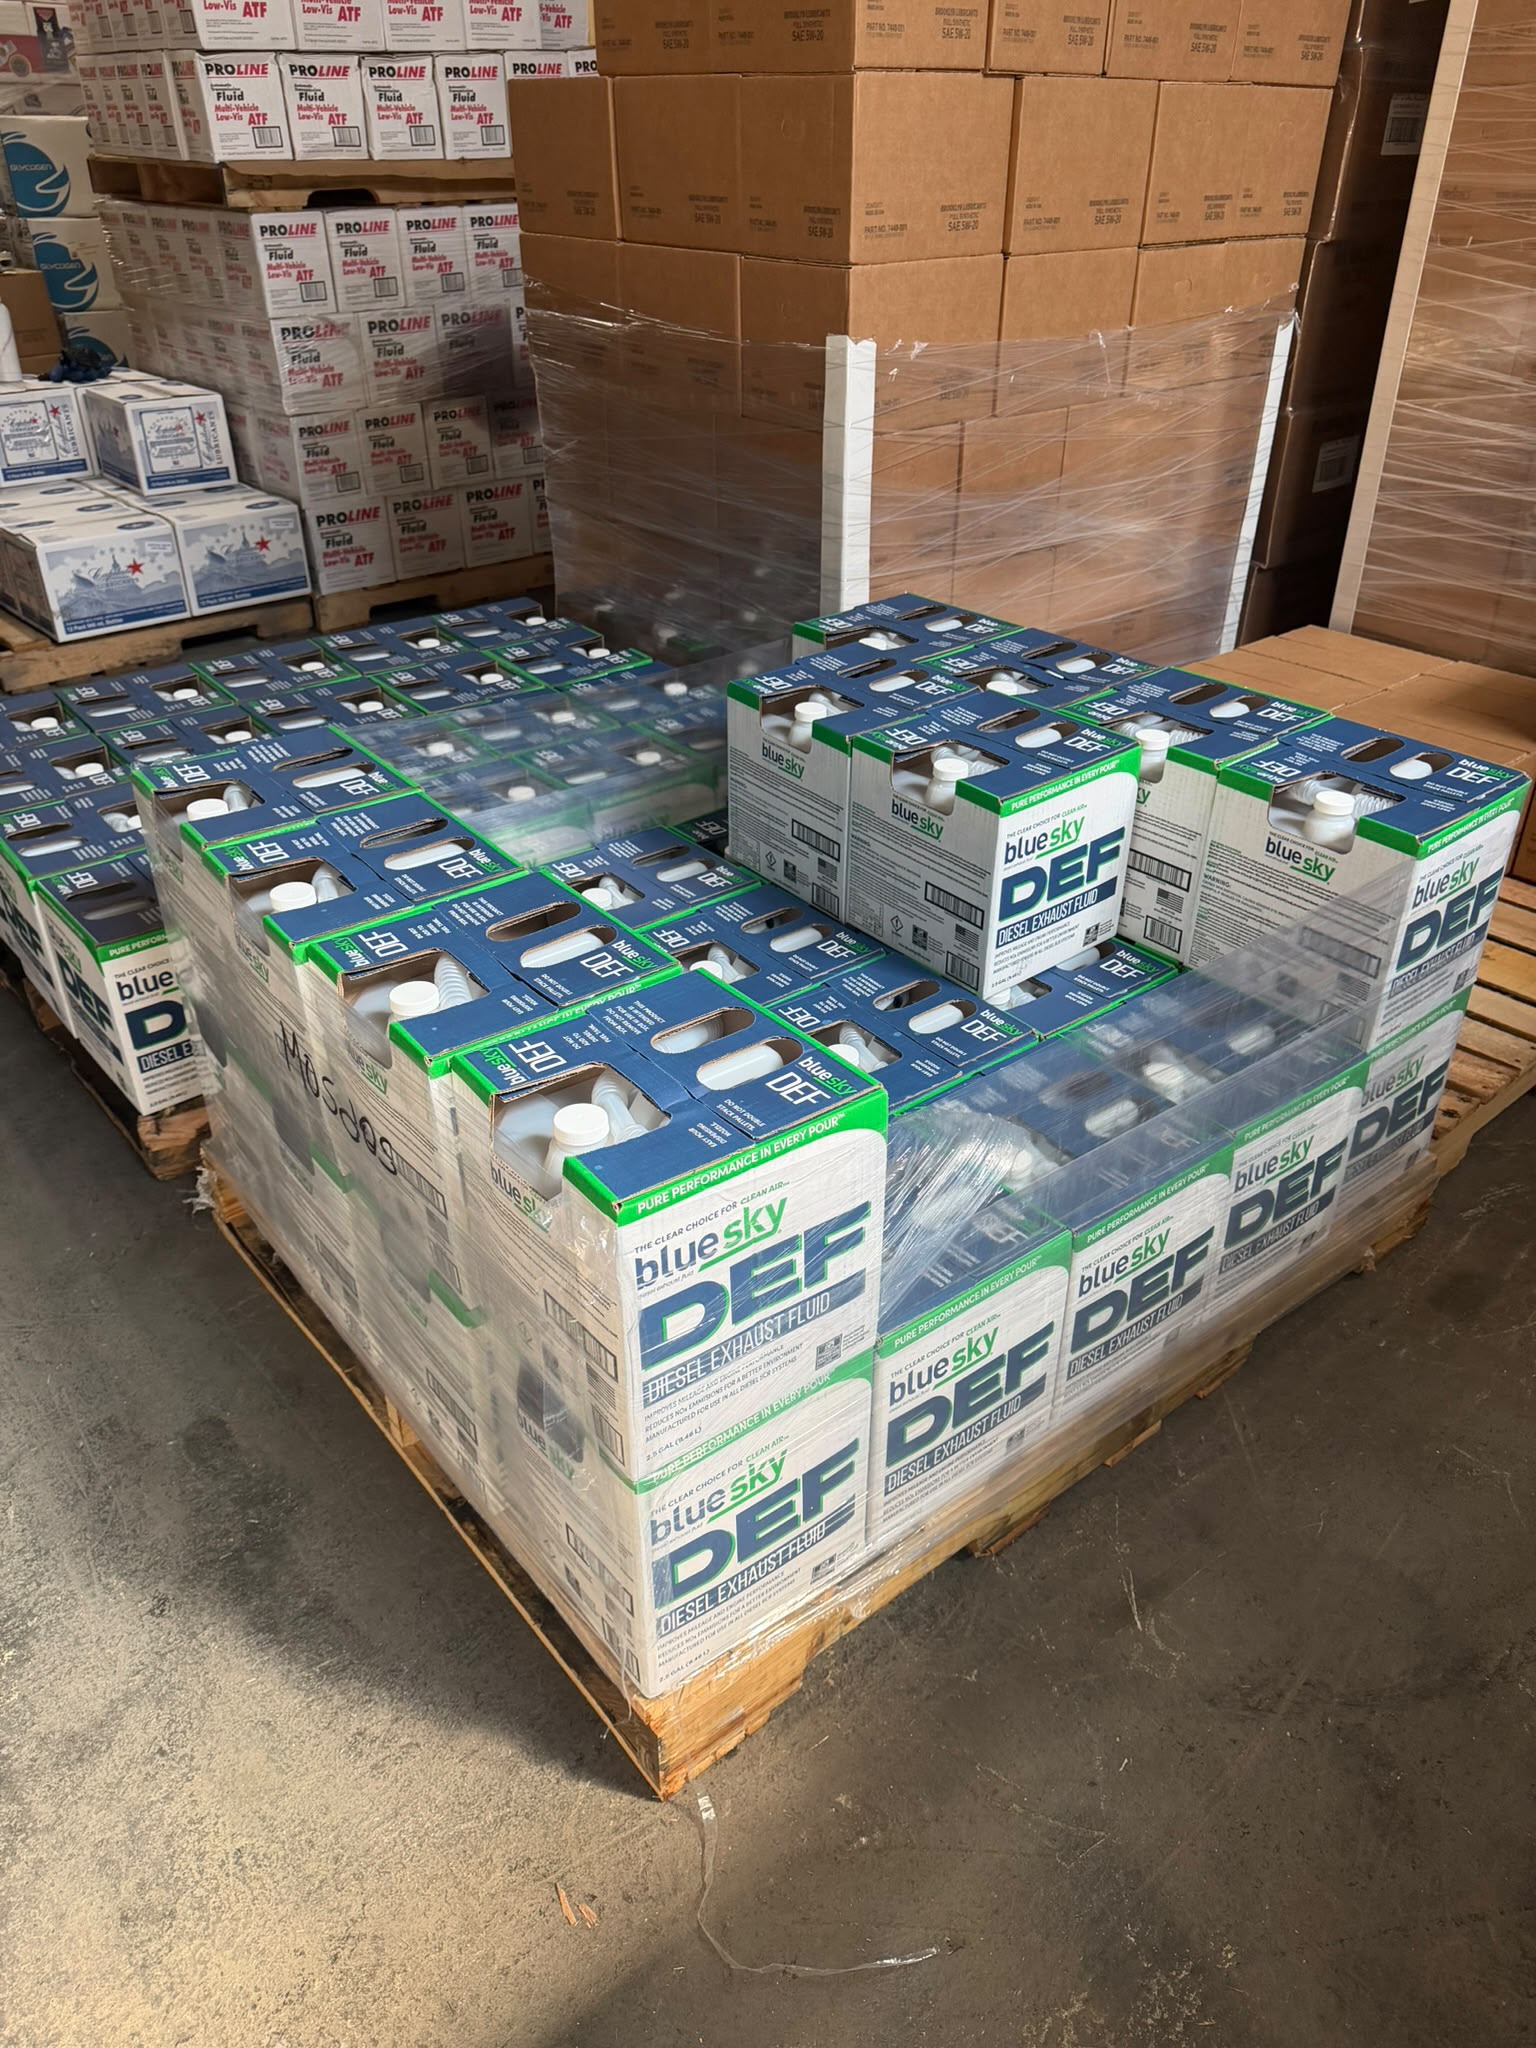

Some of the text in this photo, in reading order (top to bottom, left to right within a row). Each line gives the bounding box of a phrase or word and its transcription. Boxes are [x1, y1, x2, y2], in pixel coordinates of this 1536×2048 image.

[242, 2, 267, 17] ATF
[302, 4, 361, 22] Low-Vis ATF
[422, 7, 443, 22] ATF
[502, 7, 522, 22] ATF
[554, 15, 572, 28] ATF
[205, 63, 268, 76] PROLINE
[289, 64, 350, 77] PROLINE
[369, 66, 426, 78] PROLINE
[445, 67, 498, 78] PROLINE
[513, 63, 562, 75] PROLINE
[217, 90, 244, 101] Fluid
[299, 92, 324, 101] Fluid
[379, 92, 402, 102] Fluid
[453, 92, 476, 102] Fluid
[216, 112, 267, 125] Low-Vis ATF
[328, 114, 347, 125] ATF
[406, 113, 423, 124] ATF
[477, 113, 494, 124] ATF
[260, 223, 317, 237] PROLINE
[336, 220, 390, 234] PROLINE
[406, 218, 456, 231] PROLINE
[470, 214, 518, 228] PROLINE
[269, 250, 293, 260] Fluid
[345, 247, 368, 257] Fluid
[296, 269, 314, 282] ATF
[369, 266, 386, 278] ATF
[437, 261, 453, 273] ATF
[368, 316, 431, 334] PROLINE
[299, 420, 350, 438] PROLINE
[365, 413, 416, 429] PROLINE
[206, 409, 223, 464] LUBRICANTS
[466, 483, 522, 503] PROLINE
[393, 494, 453, 514] PROLINE
[316, 506, 380, 527] PROLINE
[325, 535, 353, 549] Fluid
[498, 528, 516, 541] ATF
[354, 553, 374, 567] ATF
[1256, 709, 1304, 724] DEF
[1064, 736, 1110, 753] DEF
[1446, 767, 1500, 785] DEF
[1011, 770, 1099, 811] PURE PERFORMANCE EVERY
[438, 857, 486, 879] DEF
[998, 826, 1125, 922] DEF
[998, 888, 1098, 946] DIESEL EXHAUST FLUID
[1396, 866, 1505, 972] DEF
[109, 944, 130, 957] PURE
[580, 952, 634, 978] DEF
[1100, 958, 1146, 980] DEF
[960, 1019, 1007, 1043] DEF
[142, 1048, 178, 1071] DIESEL
[508, 1040, 567, 1073] DEF
[765, 1071, 831, 1105] DEF
[716, 1104, 733, 1118] STACK
[1347, 1058, 1452, 1161] DEF
[637, 1191, 670, 1215] PURE
[671, 1150, 759, 1199] PERFORMANCE
[760, 1144, 772, 1159] IN
[774, 1129, 806, 1153] EVERY
[1223, 1136, 1348, 1250] DEF
[1087, 1177, 1186, 1243] PURE PERFORMANCE EVERY
[634, 1241, 652, 1254] THE
[654, 1228, 684, 1245] CLEAR
[685, 1210, 719, 1232] CHOICE
[720, 1201, 737, 1215] FOR
[740, 1187, 767, 1205] CLEAN
[637, 1200, 871, 1372] DEF
[1070, 1226, 1215, 1354] DEF
[894, 1327, 917, 1348] PURE
[918, 1291, 980, 1334] PERFORMANCE
[980, 1286, 989, 1297] IN
[990, 1271, 1014, 1292] EVERY
[1070, 1293, 1183, 1379] DIESEL EXHAUST FLUID
[648, 1292, 830, 1402] DIESEL EXHAUST FLUID
[905, 1340, 950, 1370] CLEAR CHOICE
[645, 1414, 674, 1433] REDUCES
[742, 1364, 762, 1381] BETTER
[762, 1343, 803, 1370] ENVIRONMENT
[886, 1320, 1055, 1468] DEF
[645, 1412, 696, 1444] MANUFACTURED
[683, 1415, 760, 1465] PERFORMANCE
[761, 1407, 772, 1419] IN
[773, 1389, 802, 1411] EVERY
[888, 1456, 928, 1496] DIESEL
[933, 1418, 990, 1466] EXHAUST
[991, 1395, 1022, 1428] FLUID
[668, 1470, 726, 1507] CLEAR CHOICE
[651, 1437, 860, 1610] DEF
[661, 1594, 714, 1635] DIESEL
[718, 1547, 784, 1600] EXHAUST
[788, 1522, 826, 1558] FLUID
